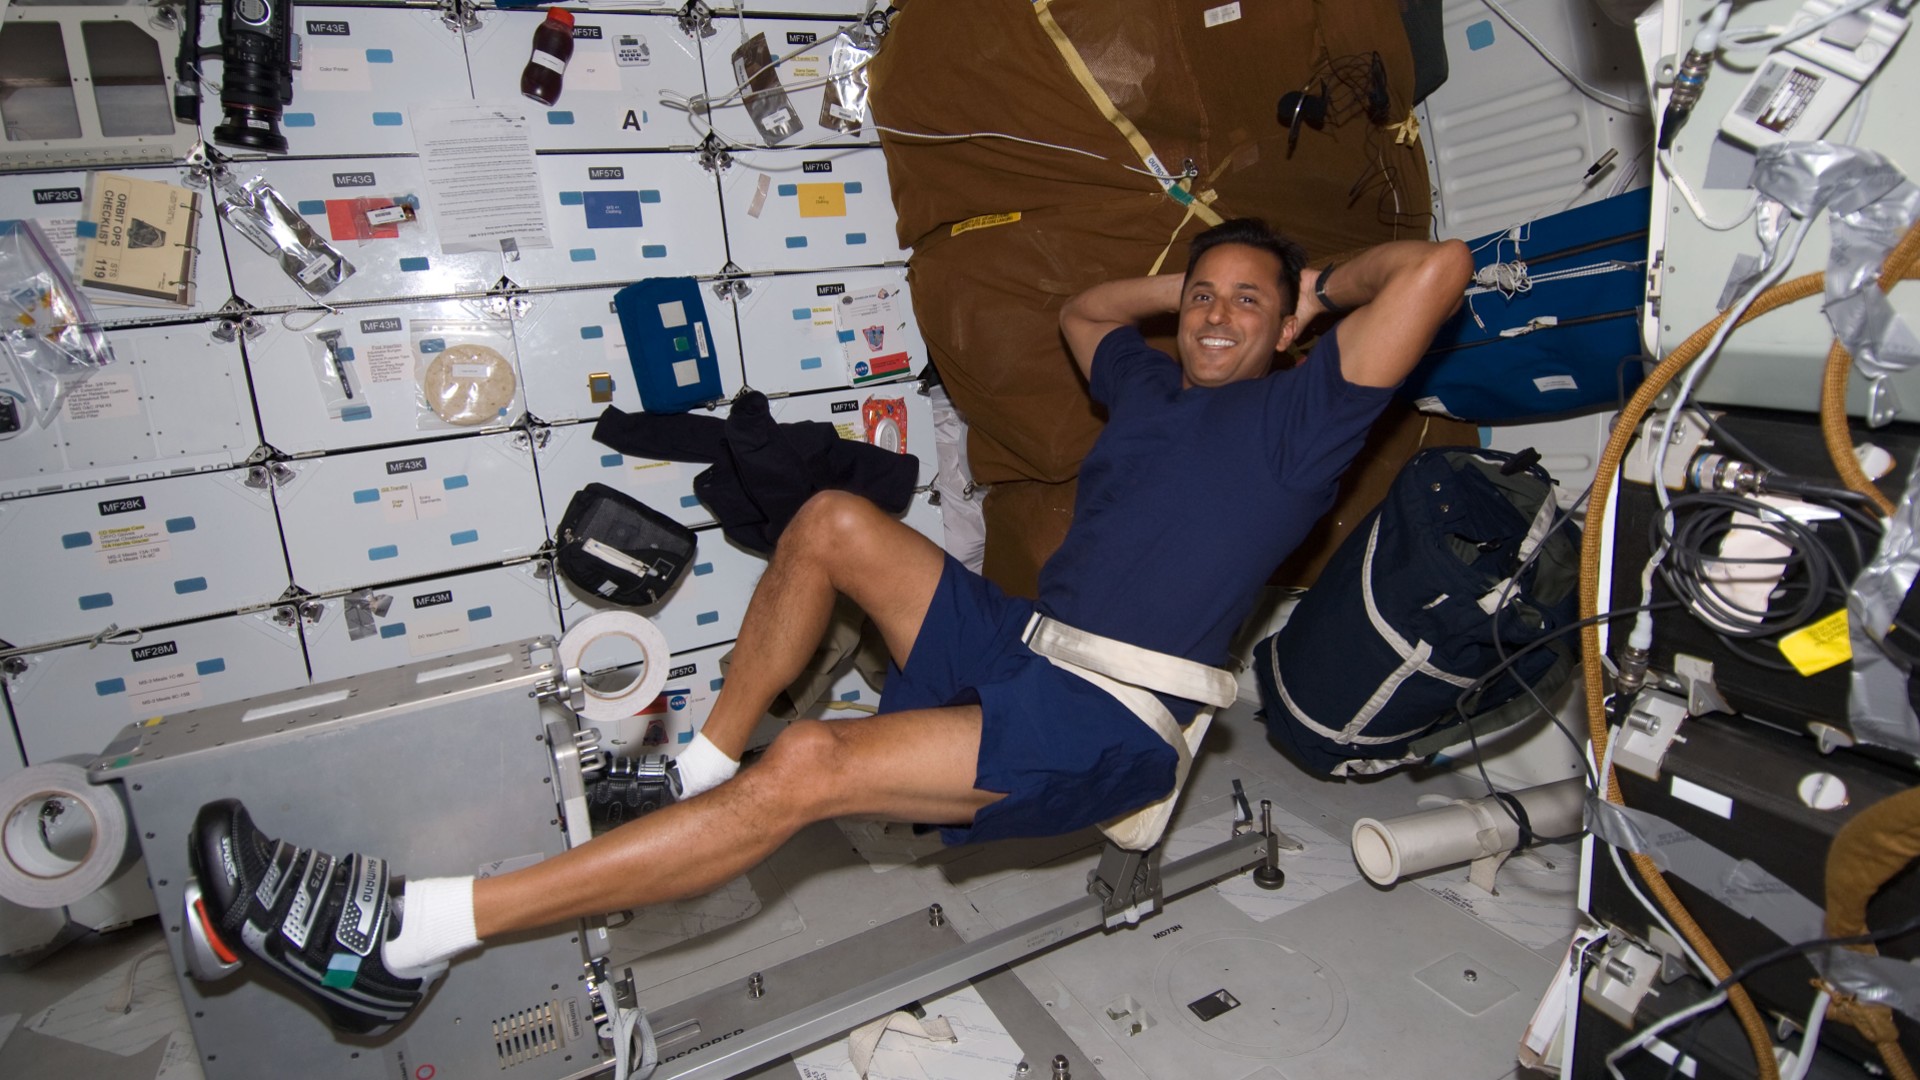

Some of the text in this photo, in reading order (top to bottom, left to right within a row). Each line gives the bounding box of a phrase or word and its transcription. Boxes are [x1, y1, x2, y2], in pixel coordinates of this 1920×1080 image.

[310, 23, 346, 33] MF43E
[789, 33, 815, 43] MF71E
[622, 109, 641, 131] A
[591, 169, 621, 177] MF57G
[805, 163, 830, 171] MF71G
[1148, 157, 1170, 185] OUTBOD
[336, 175, 373, 184] MF43G
[37, 190, 79, 202] MF28G
[98, 190, 115, 246] CHECKLIST
[112, 193, 127, 247] ORBIT OPS
[94, 259, 107, 279] 119
[818, 286, 843, 294] MF71H
[363, 320, 399, 331] MF43H
[389, 461, 423, 472] MF43K
[102, 499, 142, 513] MF28K
[416, 593, 450, 606] MF43M
[134, 643, 174, 659] MF28M
[362, 858, 377, 903] SHIMANO
[1152, 924, 1183, 940] MD73N
[568, 1000, 580, 1037] Innovision
